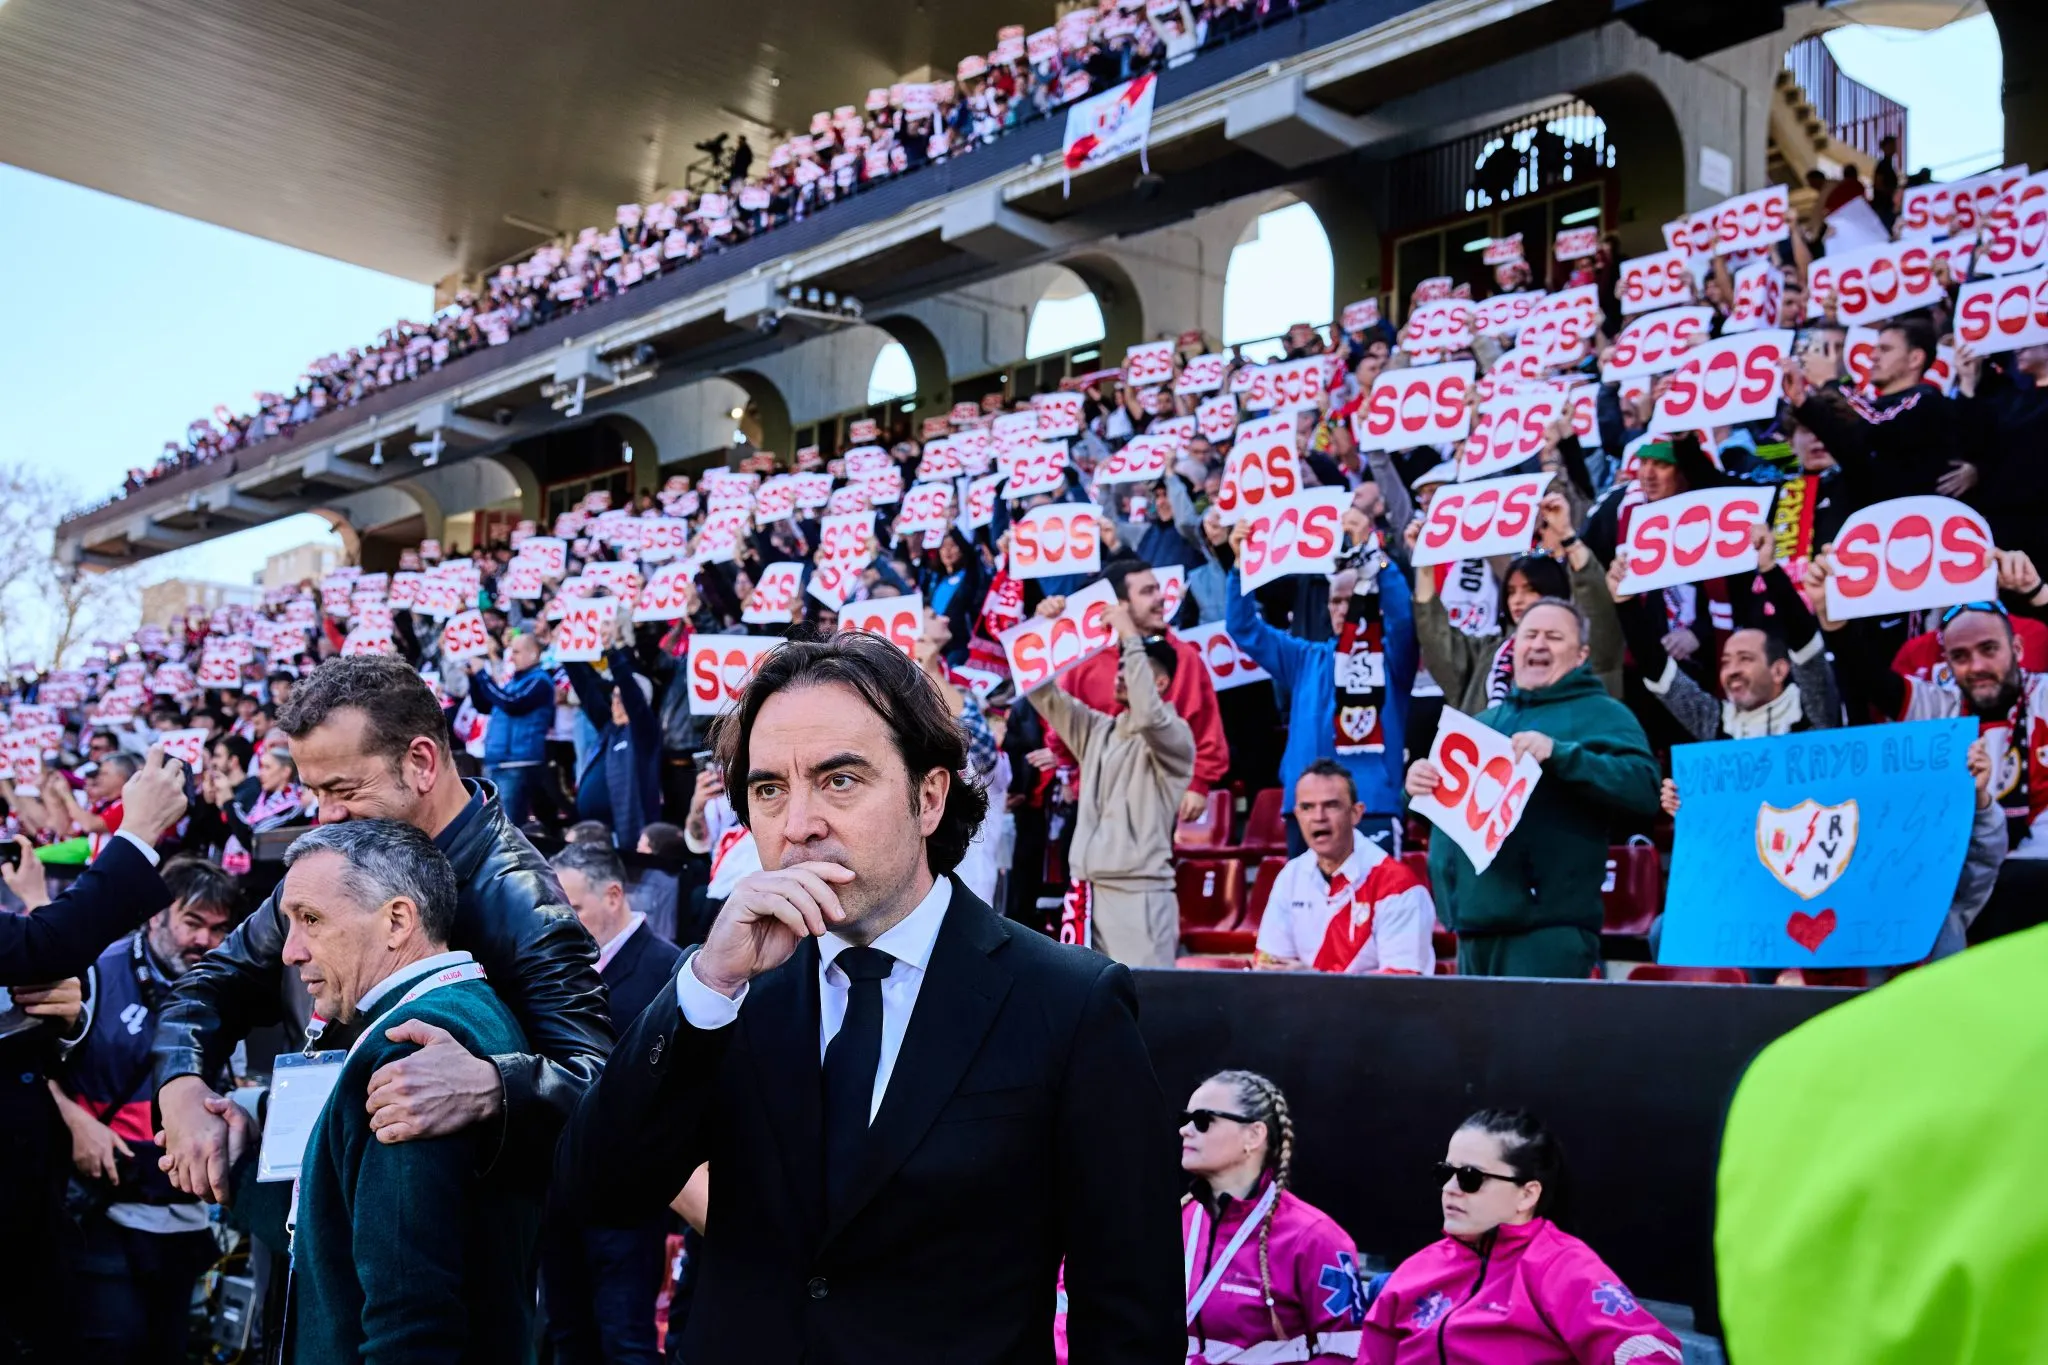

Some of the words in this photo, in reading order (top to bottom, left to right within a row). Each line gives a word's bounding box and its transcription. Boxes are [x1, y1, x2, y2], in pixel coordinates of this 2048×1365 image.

[1672, 216, 1719, 258] SO
[1720, 197, 1785, 243] SOS
[1626, 256, 1685, 302] SOS
[1838, 247, 1934, 315] SOS
[1407, 307, 1467, 340] SOS
[1474, 299, 1530, 330] SOS
[1130, 349, 1169, 378] SOS
[1612, 316, 1700, 368] SOS
[1179, 361, 1222, 387] SOS
[1274, 366, 1319, 406] SOS
[1664, 344, 1781, 417] SOS
[1367, 376, 1466, 436] SOS
[1465, 404, 1552, 466] SOS
[1010, 451, 1065, 490] SOS
[1015, 513, 1095, 567] SOS
[1424, 483, 1539, 549] SOS
[1629, 500, 1760, 576] SOS
[822, 521, 869, 561] SOS
[1244, 505, 1338, 577] SOS
[1836, 514, 1989, 598] SOS
[445, 618, 485, 652] SOS
[560, 609, 599, 650] SOS
[1013, 600, 1113, 690] SOS
[1433, 732, 1528, 852] SOS
[1677, 747, 1773, 797] VAMOS
[1786, 741, 1868, 786] RAYO
[438, 970, 463, 983] LALIGA
